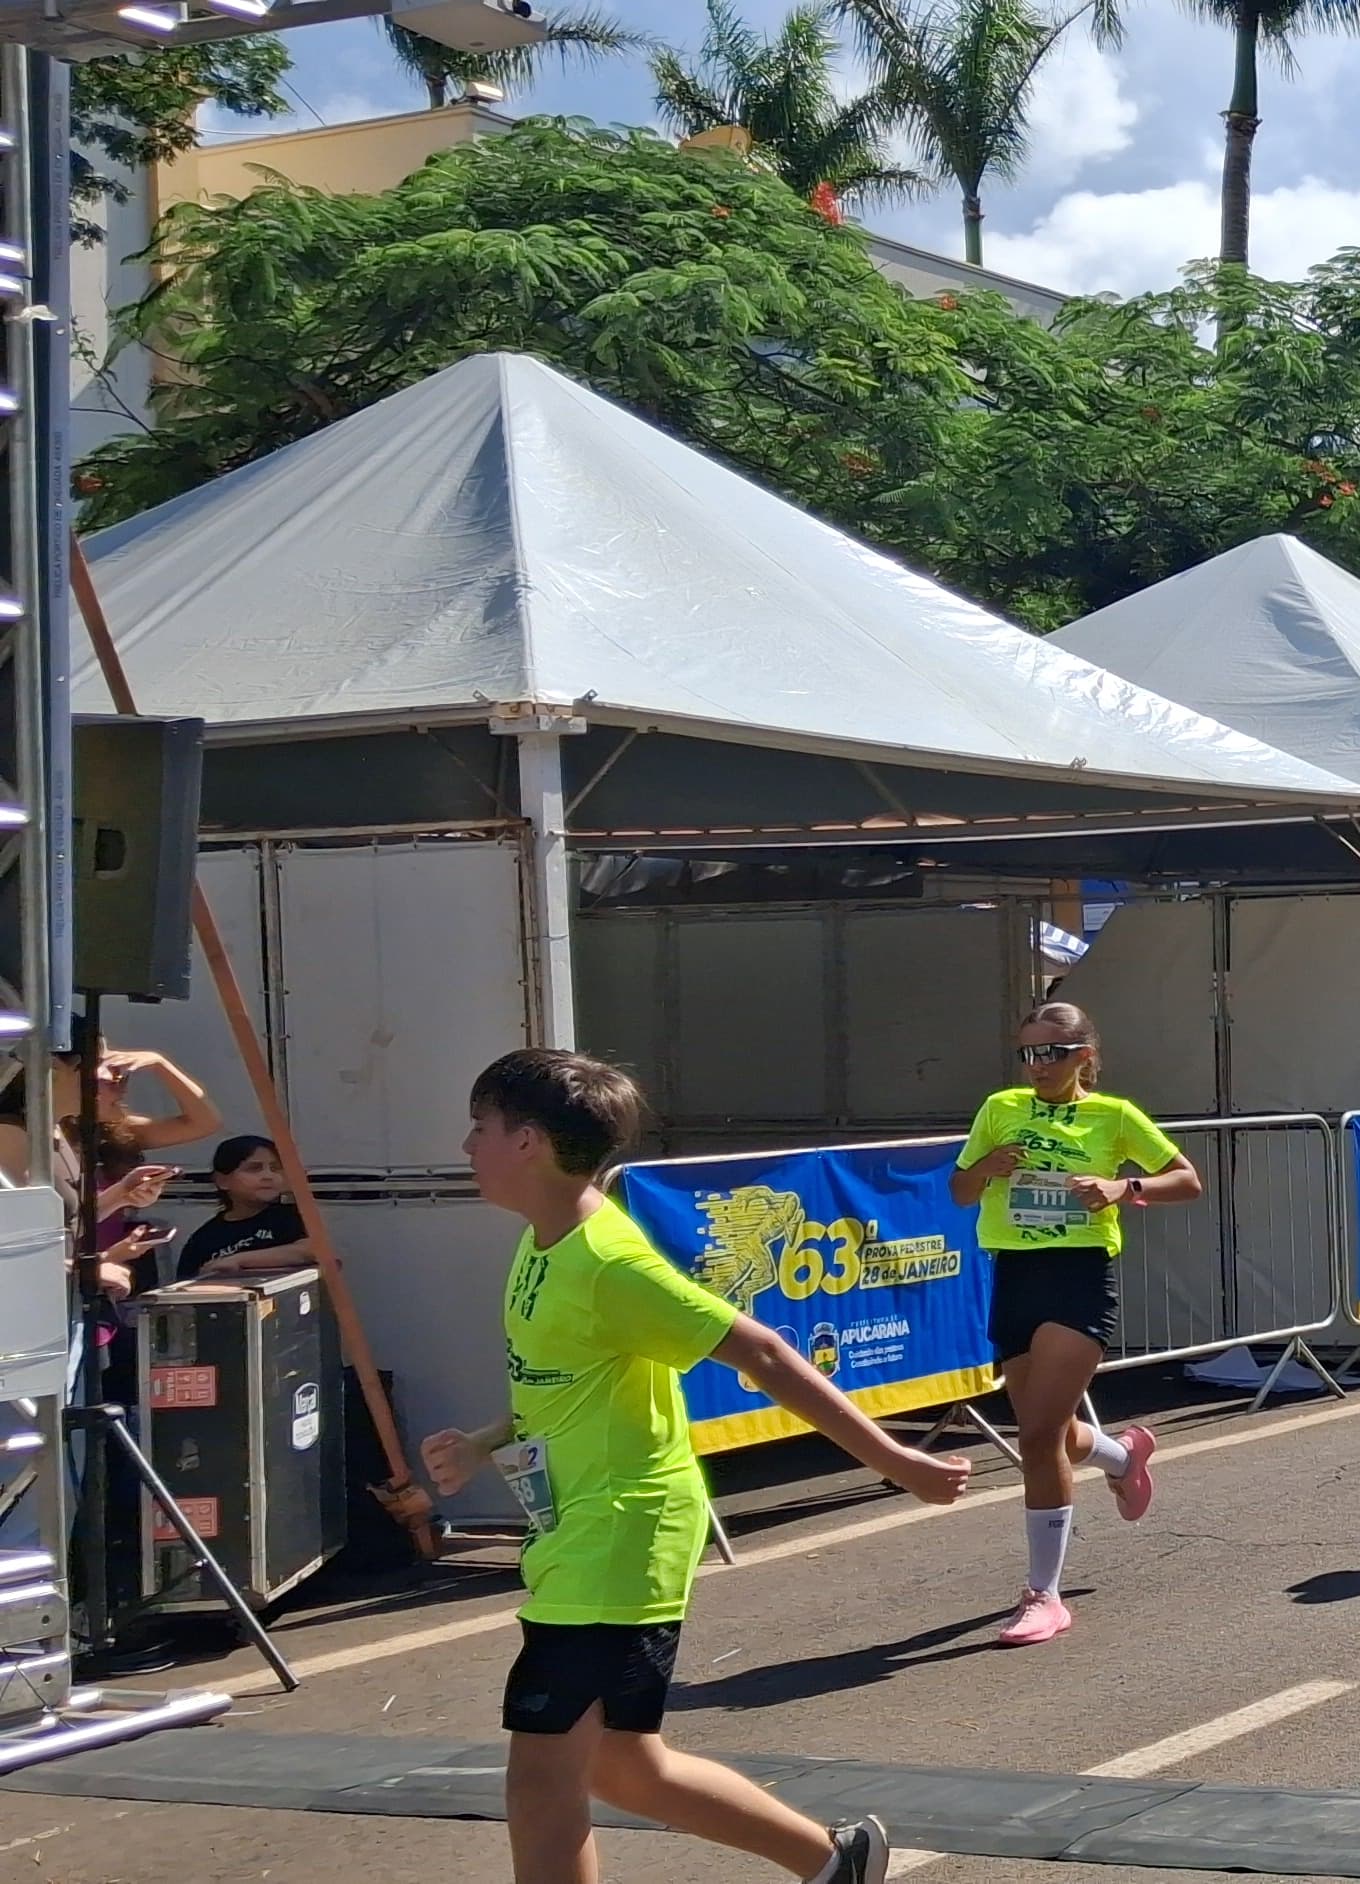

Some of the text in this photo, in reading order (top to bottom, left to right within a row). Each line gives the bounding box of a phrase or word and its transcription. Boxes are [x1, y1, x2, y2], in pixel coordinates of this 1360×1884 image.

[1031, 1189, 1067, 1206] 1111
[864, 1244, 899, 1260] PROVA
[861, 1254, 959, 1286] 28 de JANEIRO
[840, 1319, 911, 1346] APUCARANA
